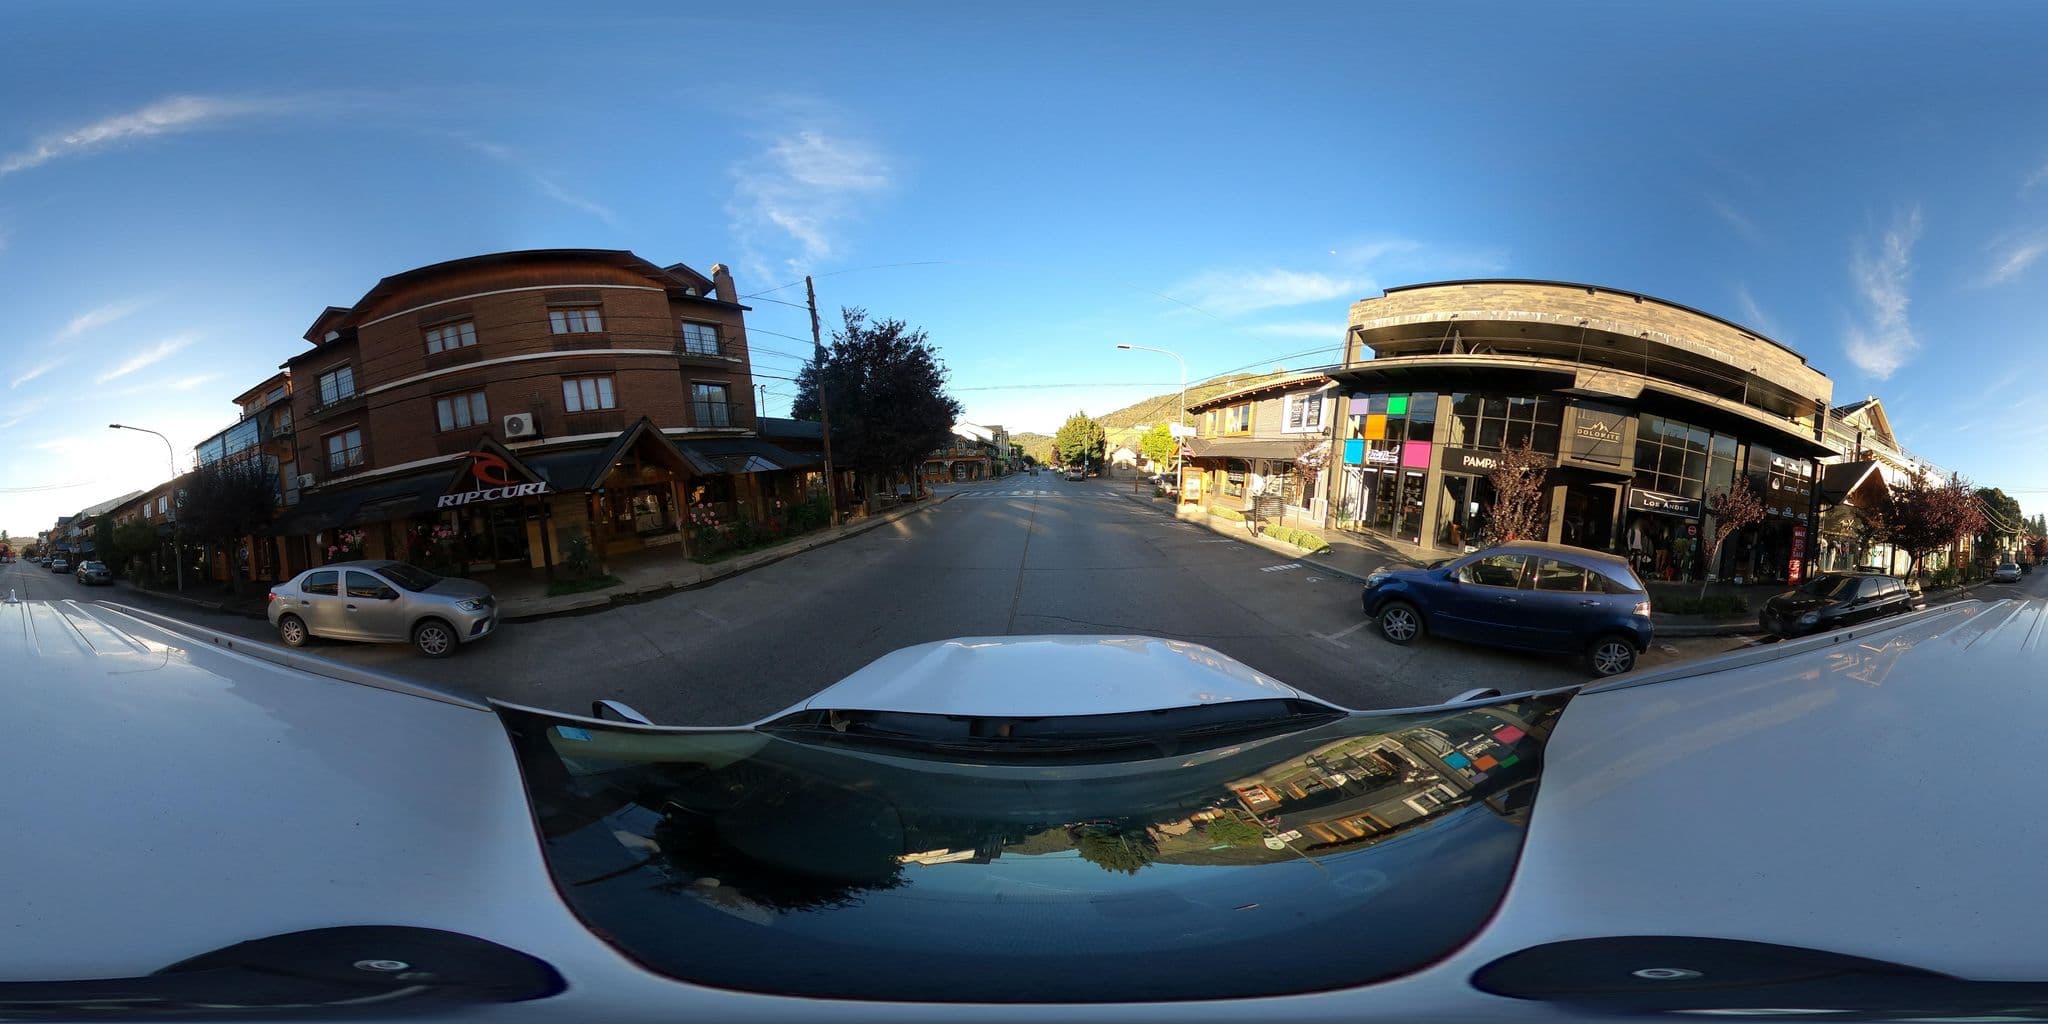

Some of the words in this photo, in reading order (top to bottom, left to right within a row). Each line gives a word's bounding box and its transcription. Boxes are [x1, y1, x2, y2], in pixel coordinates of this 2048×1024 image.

[1577, 428, 1620, 441] DOLOMITE
[437, 490, 480, 508] RIP
[482, 481, 549, 502] CURL
[1643, 499, 1660, 507] LOS
[1663, 501, 1689, 512] ANDES
